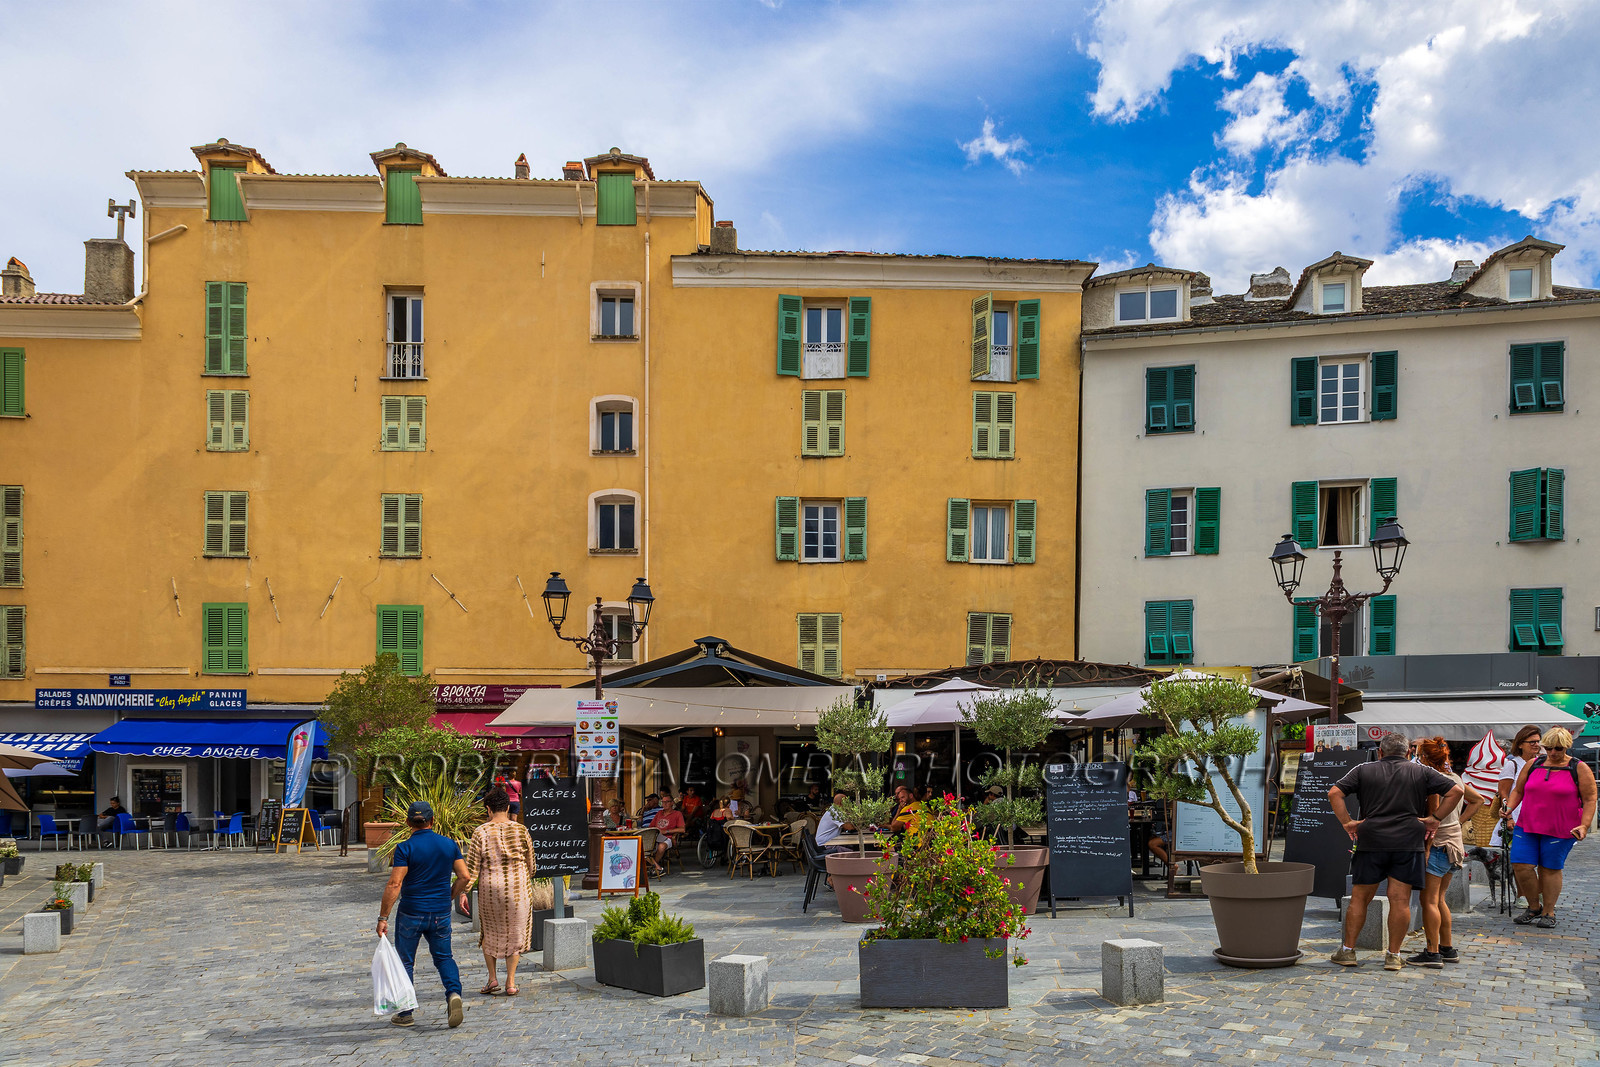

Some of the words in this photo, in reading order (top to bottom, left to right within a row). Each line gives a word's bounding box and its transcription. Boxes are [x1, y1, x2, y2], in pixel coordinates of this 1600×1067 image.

[209, 691, 242, 699] PANINI
[441, 685, 487, 698] SPORTA
[38, 698, 72, 707] CRÊPES
[76, 693, 155, 707] SANDWICHERIE
[152, 746, 192, 755] CHEZ
[201, 745, 260, 757] ANGÈLE
[532, 787, 577, 799] CRÊPES
[529, 808, 561, 817] GLACES
[530, 823, 572, 831] GAUFRES
[532, 840, 586, 849] BRUSHETTE
